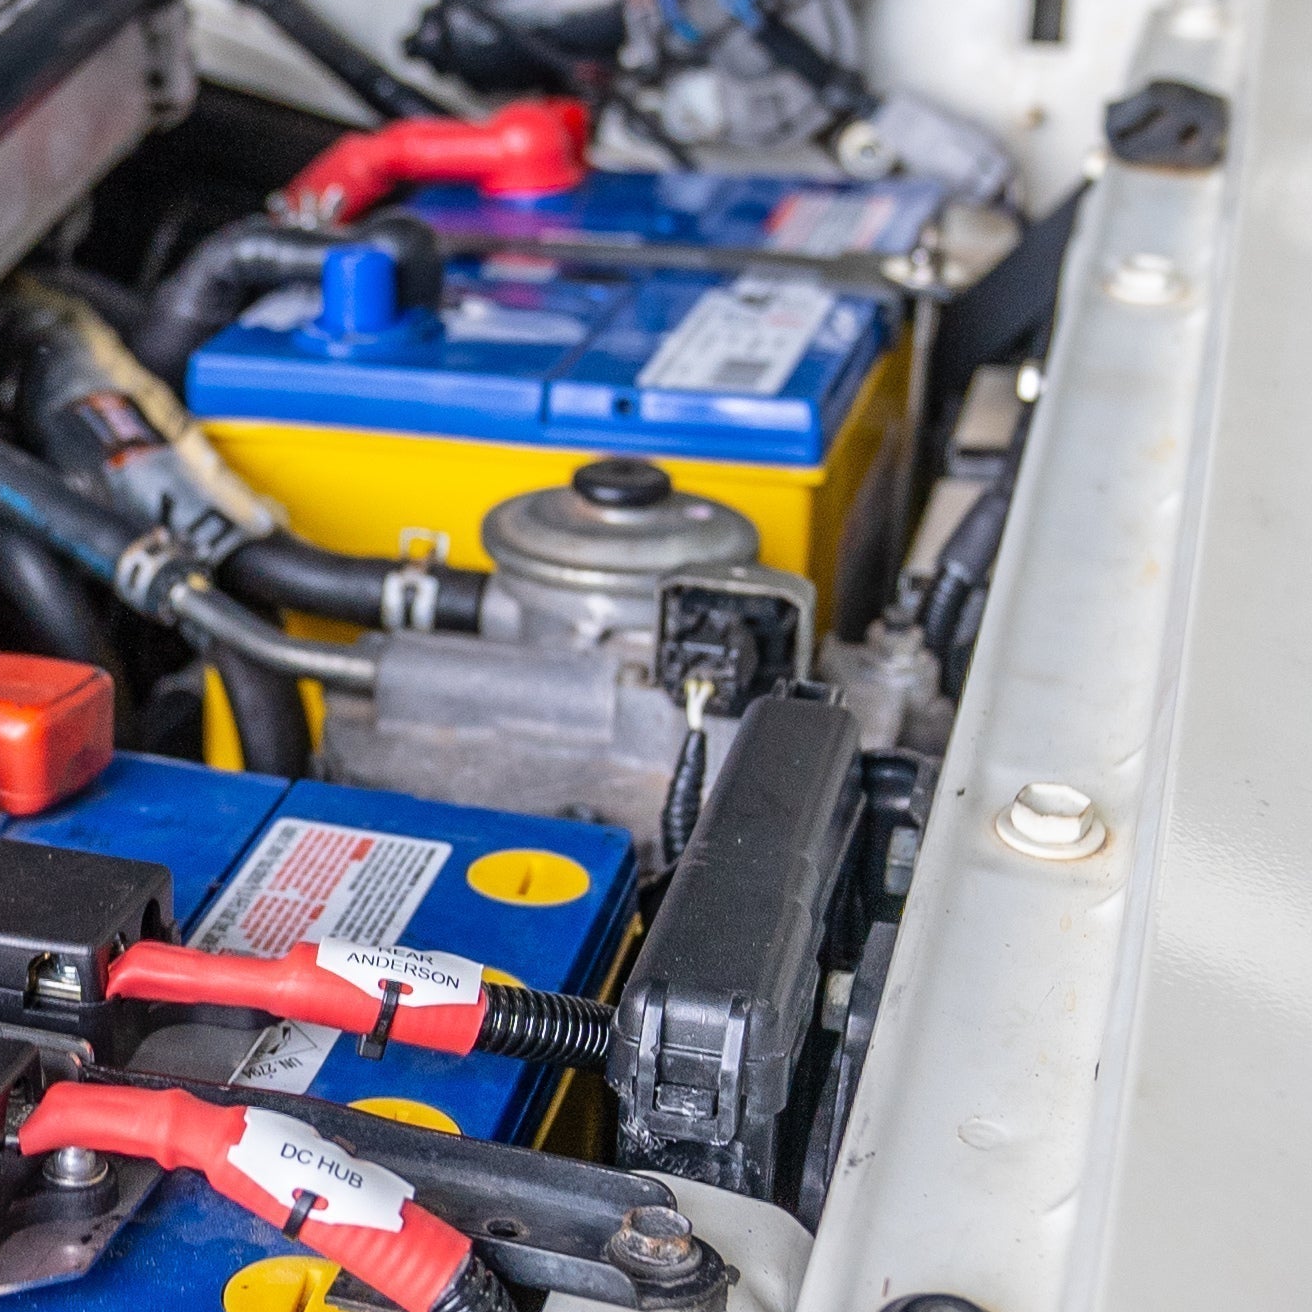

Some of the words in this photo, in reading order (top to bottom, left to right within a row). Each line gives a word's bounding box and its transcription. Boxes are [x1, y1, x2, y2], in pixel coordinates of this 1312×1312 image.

[347, 952, 460, 990] ANDERSON
[280, 1142, 314, 1166] DC
[317, 1155, 364, 1190] HUB
